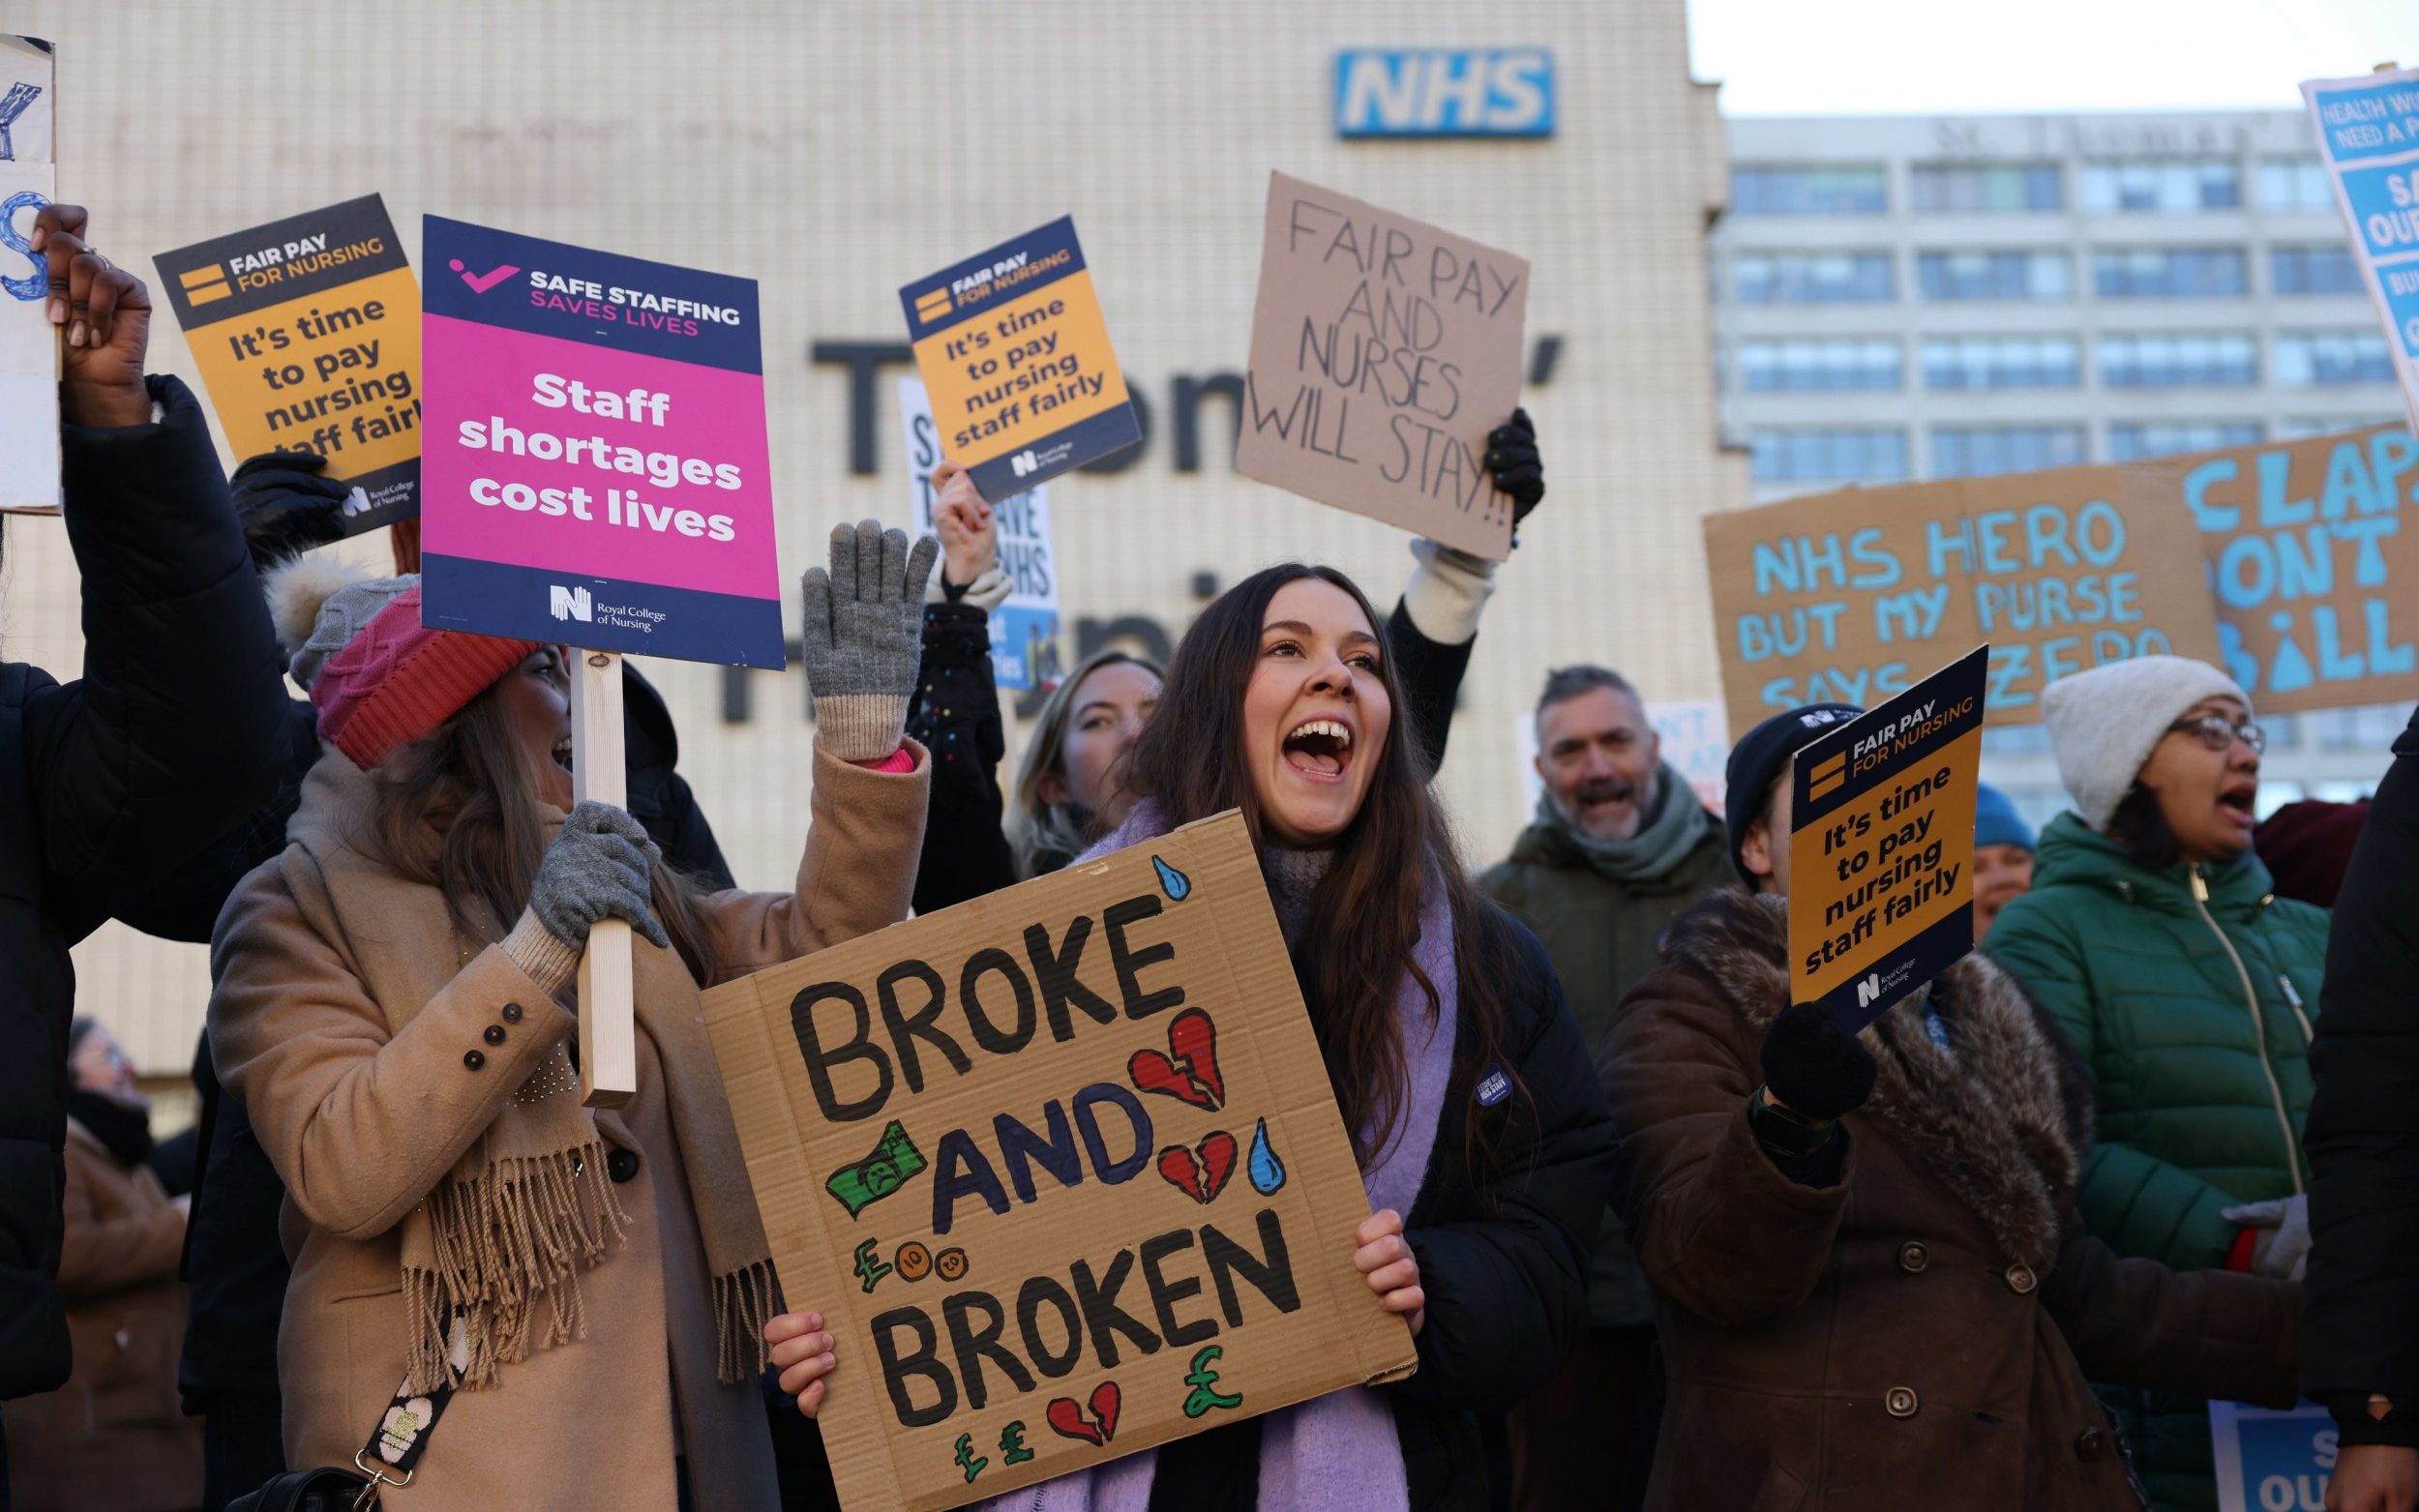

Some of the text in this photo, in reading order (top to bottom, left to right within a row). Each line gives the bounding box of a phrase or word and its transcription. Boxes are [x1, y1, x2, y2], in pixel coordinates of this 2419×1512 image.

[1344, 55, 1544, 130] NHS
[2322, 96, 2388, 125] HEALTH
[2335, 124, 2384, 148] NEED
[2387, 121, 2405, 142] A
[229, 233, 327, 275] FAIR PAY
[237, 237, 385, 292] FOR NURSING
[952, 251, 1029, 294] FAIR PAY
[957, 249, 1071, 308] FOR NURSING
[1290, 199, 1519, 317] FAIR PAY
[529, 271, 740, 326] SAFE STAFFING
[529, 290, 699, 337] SAVES LIVES
[1339, 279, 1444, 351] AND
[228, 300, 385, 361] It's time
[945, 299, 1065, 361] It's time
[968, 331, 1058, 380] to pay
[263, 340, 379, 390] to pay
[965, 353, 1078, 413] nursing
[1299, 315, 1462, 421] NURSES
[265, 371, 412, 431] nursing
[351, 399, 421, 444] fairl
[531, 372, 671, 427] Staff
[954, 402, 1021, 448] staff
[1029, 371, 1104, 416] fairly
[1248, 370, 1359, 464] WILL
[458, 415, 742, 490] shortages
[469, 477, 735, 542] cost lives
[1752, 499, 2127, 597] NHS HERO
[597, 602, 667, 622] Royal College
[597, 613, 652, 633] of Nursing
[1736, 572, 2145, 663] BUT MY PURSE
[1853, 698, 1936, 759] FAIR PAY
[1853, 696, 1973, 778] FOR NURSING
[1824, 765, 1952, 856] It's time
[1837, 809, 1935, 882] to pay
[1825, 839, 1942, 927] nursing
[1806, 861, 1961, 976] staff fairly
[789, 893, 1185, 1122] BROKE
[932, 1082, 1154, 1235] AND
[870, 1208, 1301, 1428] BROKEN
